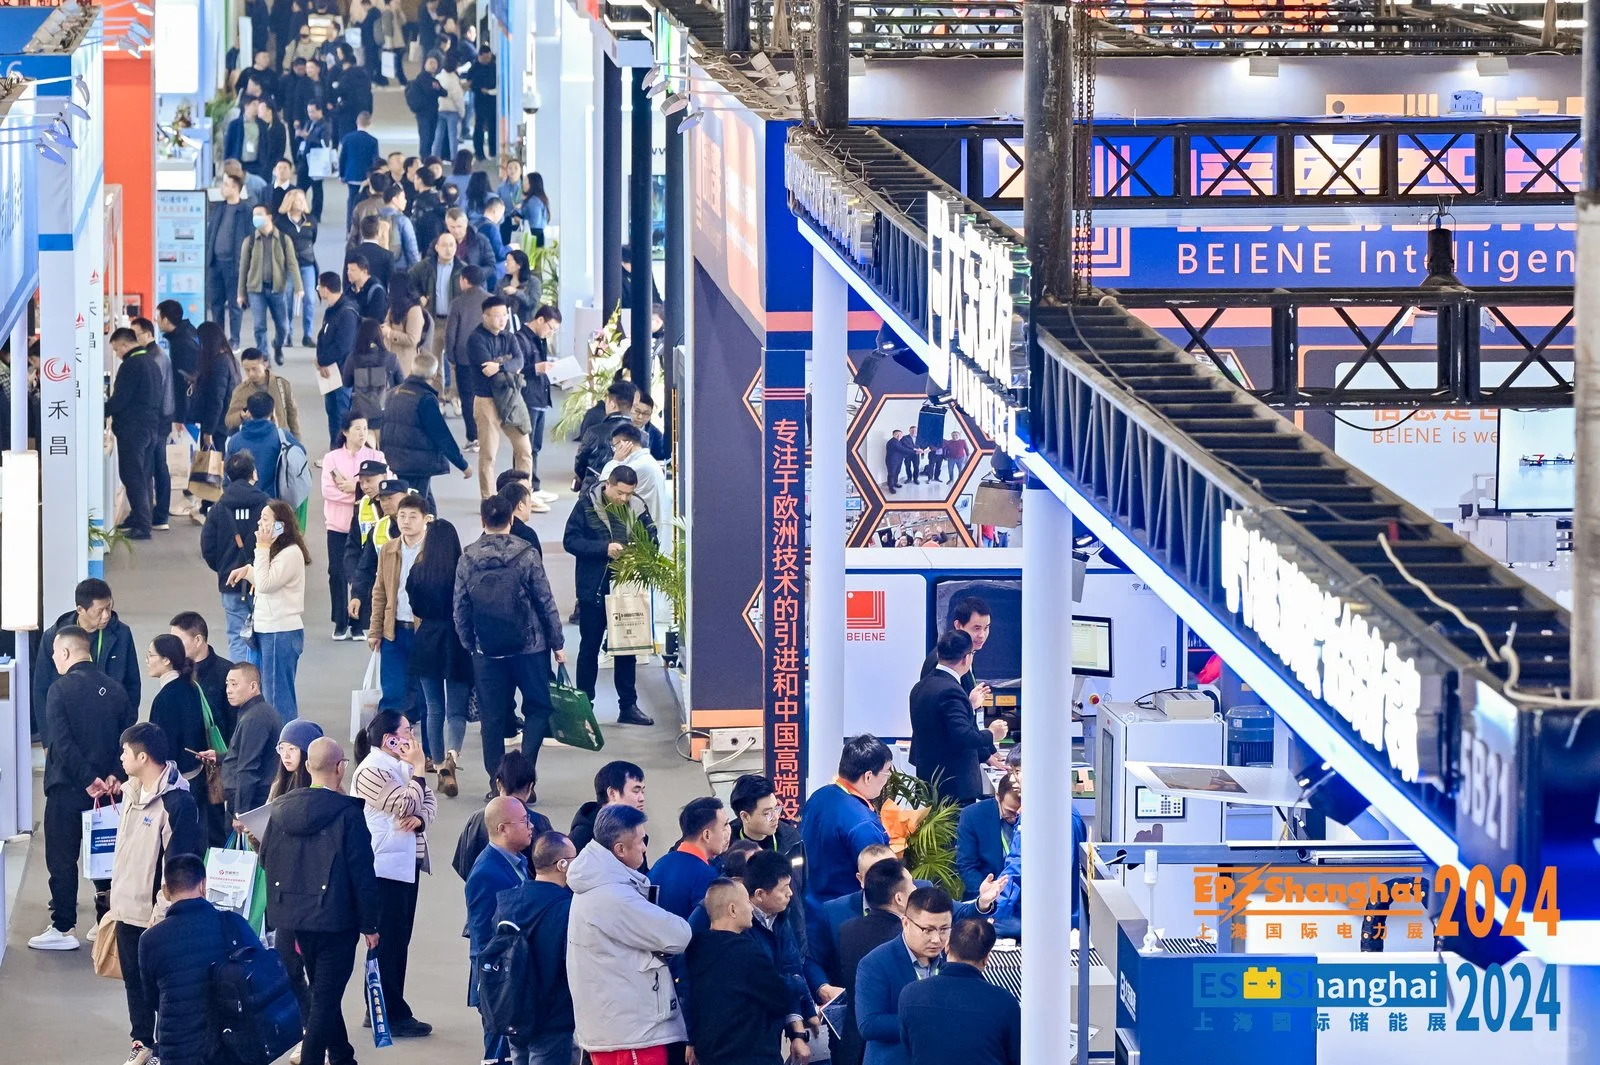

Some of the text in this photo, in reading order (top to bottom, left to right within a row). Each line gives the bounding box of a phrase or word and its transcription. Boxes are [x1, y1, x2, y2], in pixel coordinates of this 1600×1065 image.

[1178, 242, 1331, 274] BEIENE
[48, 399, 69, 456] 禾昌
[1373, 427, 1442, 444] BEIENE
[1453, 427, 1467, 444] is
[846, 632, 886, 642] BEIENE
